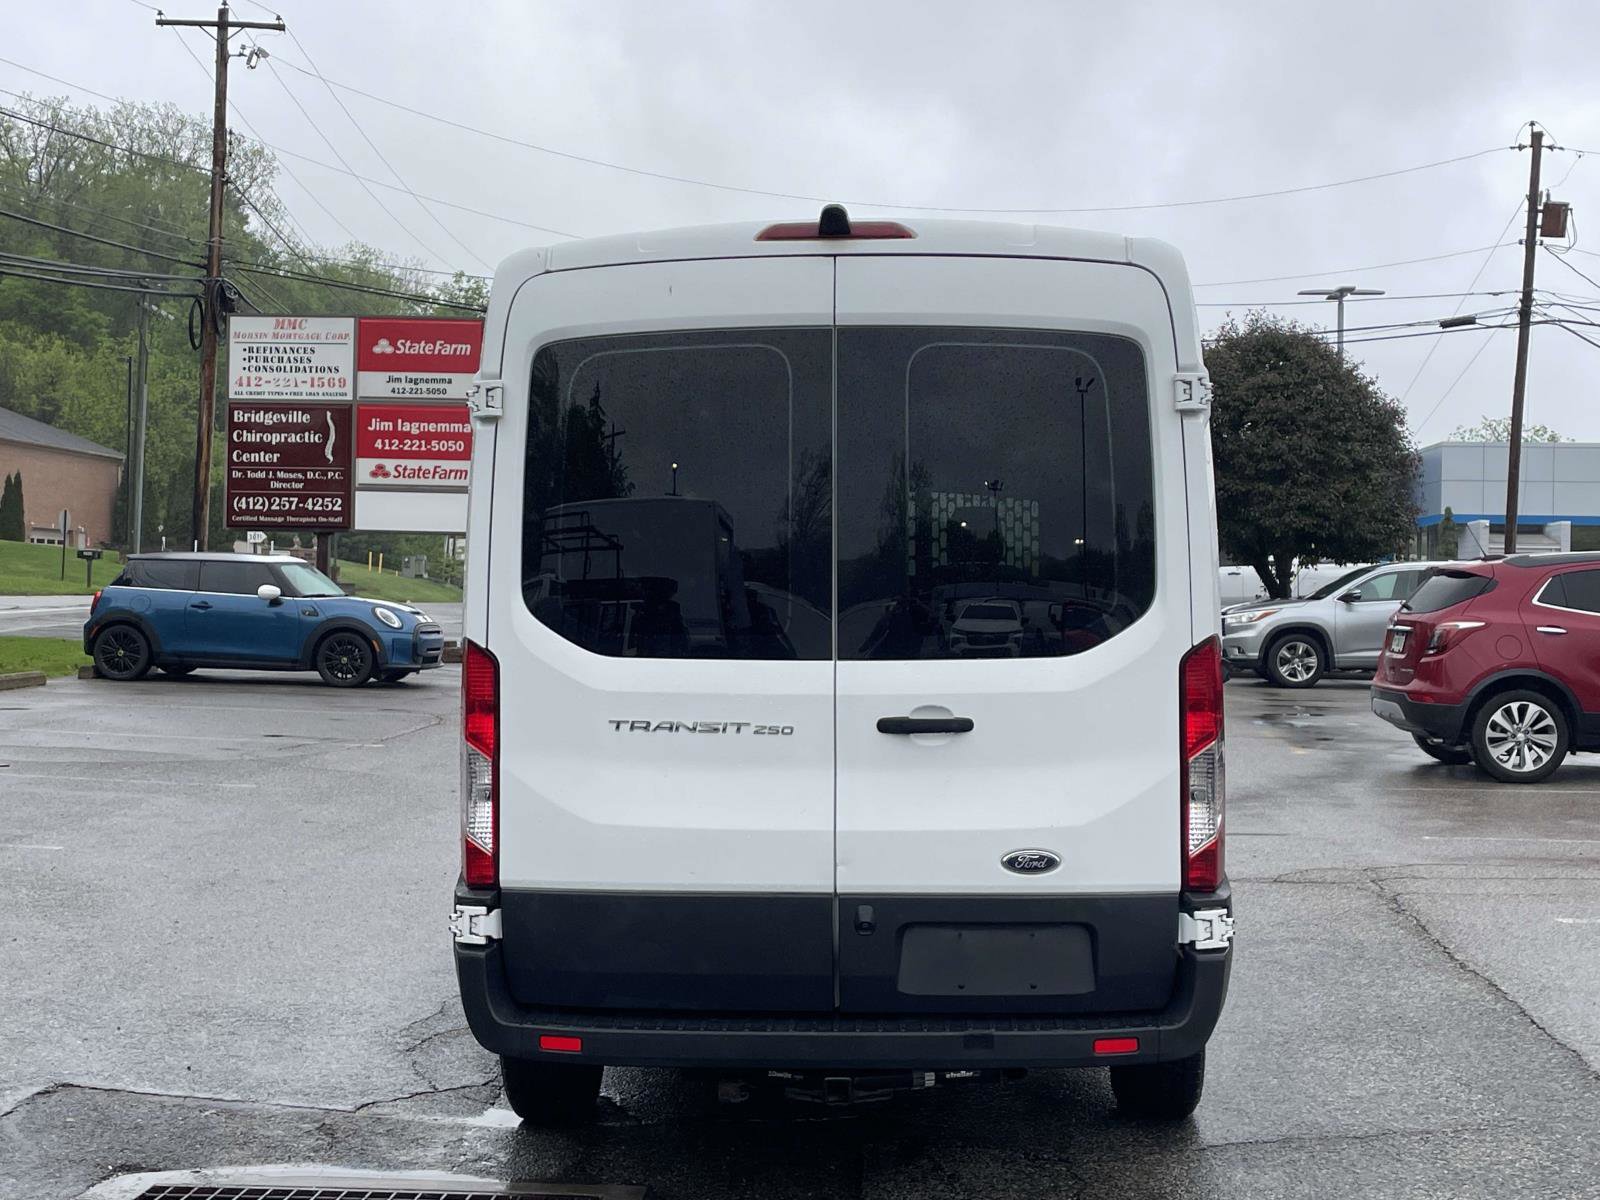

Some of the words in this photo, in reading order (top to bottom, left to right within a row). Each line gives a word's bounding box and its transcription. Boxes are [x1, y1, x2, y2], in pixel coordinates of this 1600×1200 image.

[273, 318, 308, 330] MMC
[248, 346, 316, 355] REFINANCES
[248, 356, 312, 364] PURCHASES
[248, 365, 340, 374] CONSOLIDATIONS
[235, 376, 347, 388] 412-221-1569
[386, 375, 402, 384] Jim
[391, 387, 447, 395] 412-221-5050
[233, 409, 311, 426] Bridgeville
[368, 418, 393, 431] Jim
[232, 429, 323, 445] Chiropractic
[374, 439, 465, 452] 412-221-5050
[232, 449, 280, 463] Center
[232, 470, 245, 479] Dr.
[247, 470, 266, 479] Todd
[267, 471, 275, 479] J.
[276, 471, 305, 480] Moses,
[327, 471, 344, 480] P.C.
[270, 480, 304, 489] Director
[232, 514, 258, 522] Certified
[608, 719, 751, 735] TRANSIT
[753, 725, 795, 736] 250
[1014, 855, 1048, 869] Ford
